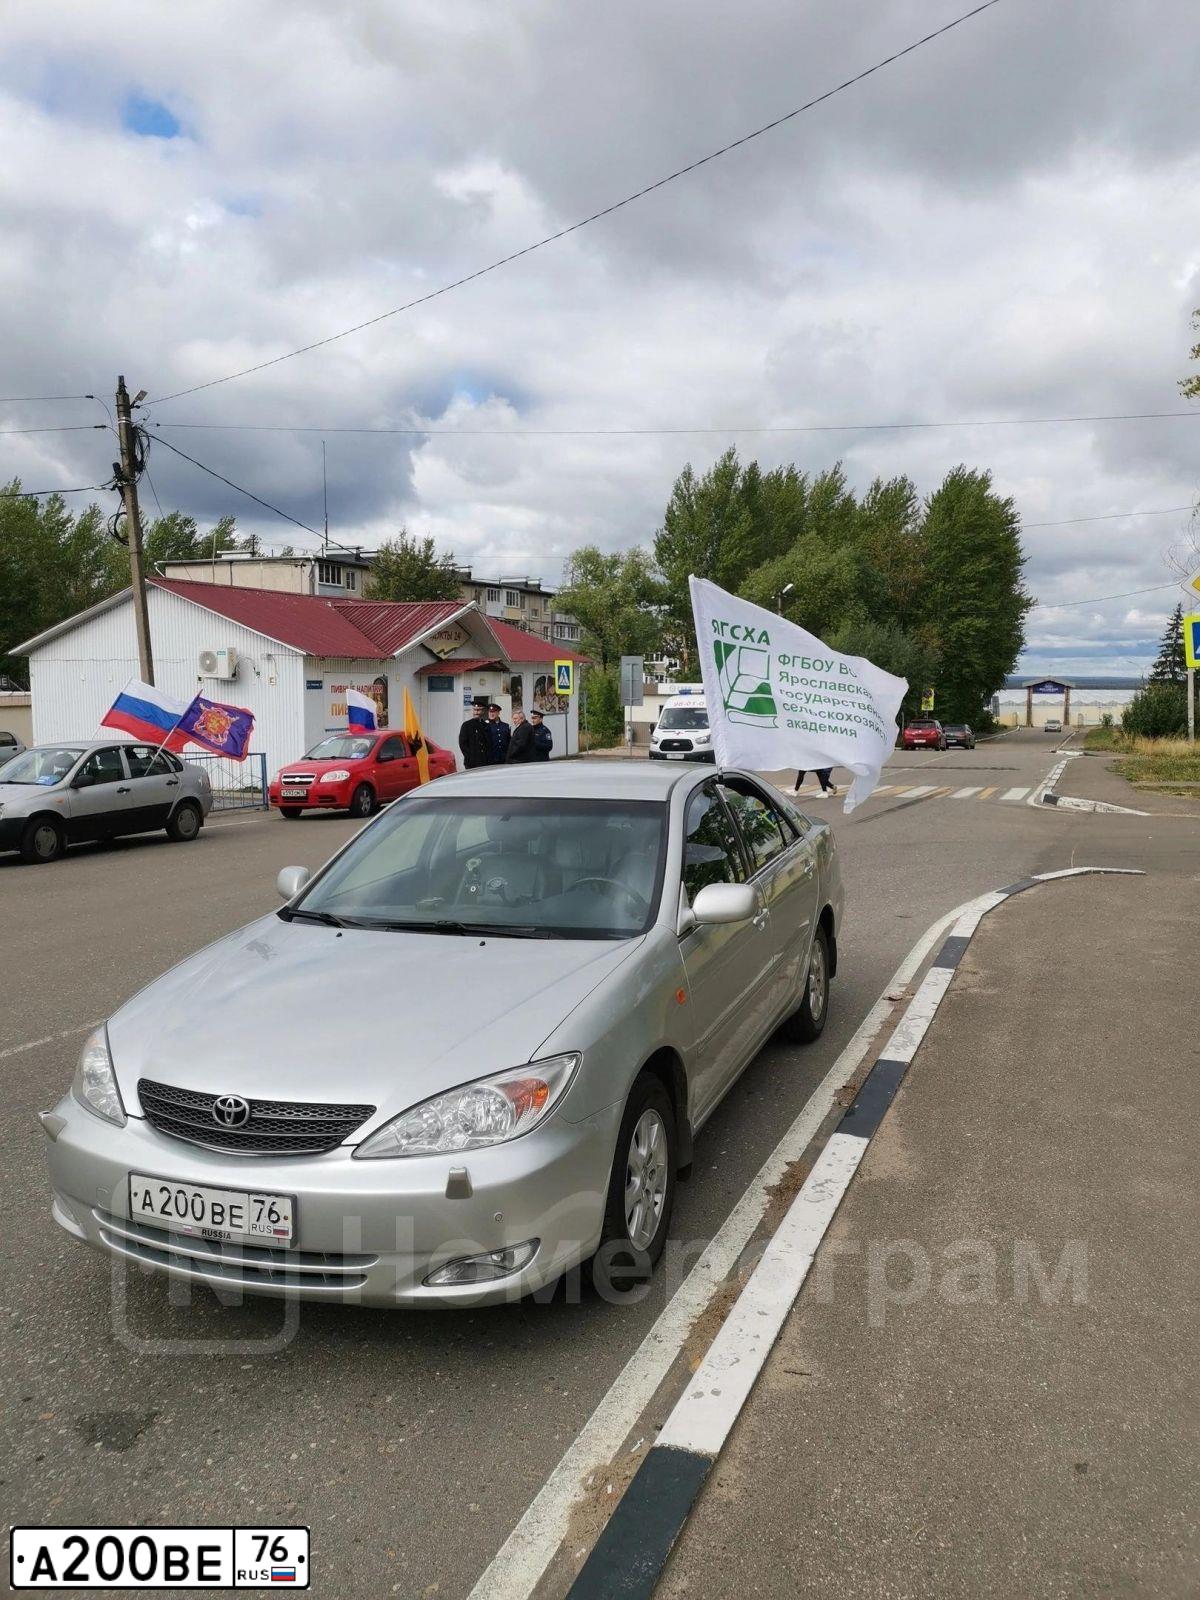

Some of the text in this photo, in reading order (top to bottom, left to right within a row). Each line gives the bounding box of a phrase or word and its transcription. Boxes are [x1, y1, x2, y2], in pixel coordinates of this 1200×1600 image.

[711, 618, 770, 646] ЯГСХА
[777, 654, 834, 673] ФГБОУ
[787, 719, 857, 738] академия
[141, 1186, 281, 1229] А200ВЕ 76
[201, 1228, 232, 1240] RUSSIA
[252, 1223, 272, 1234] RUS
